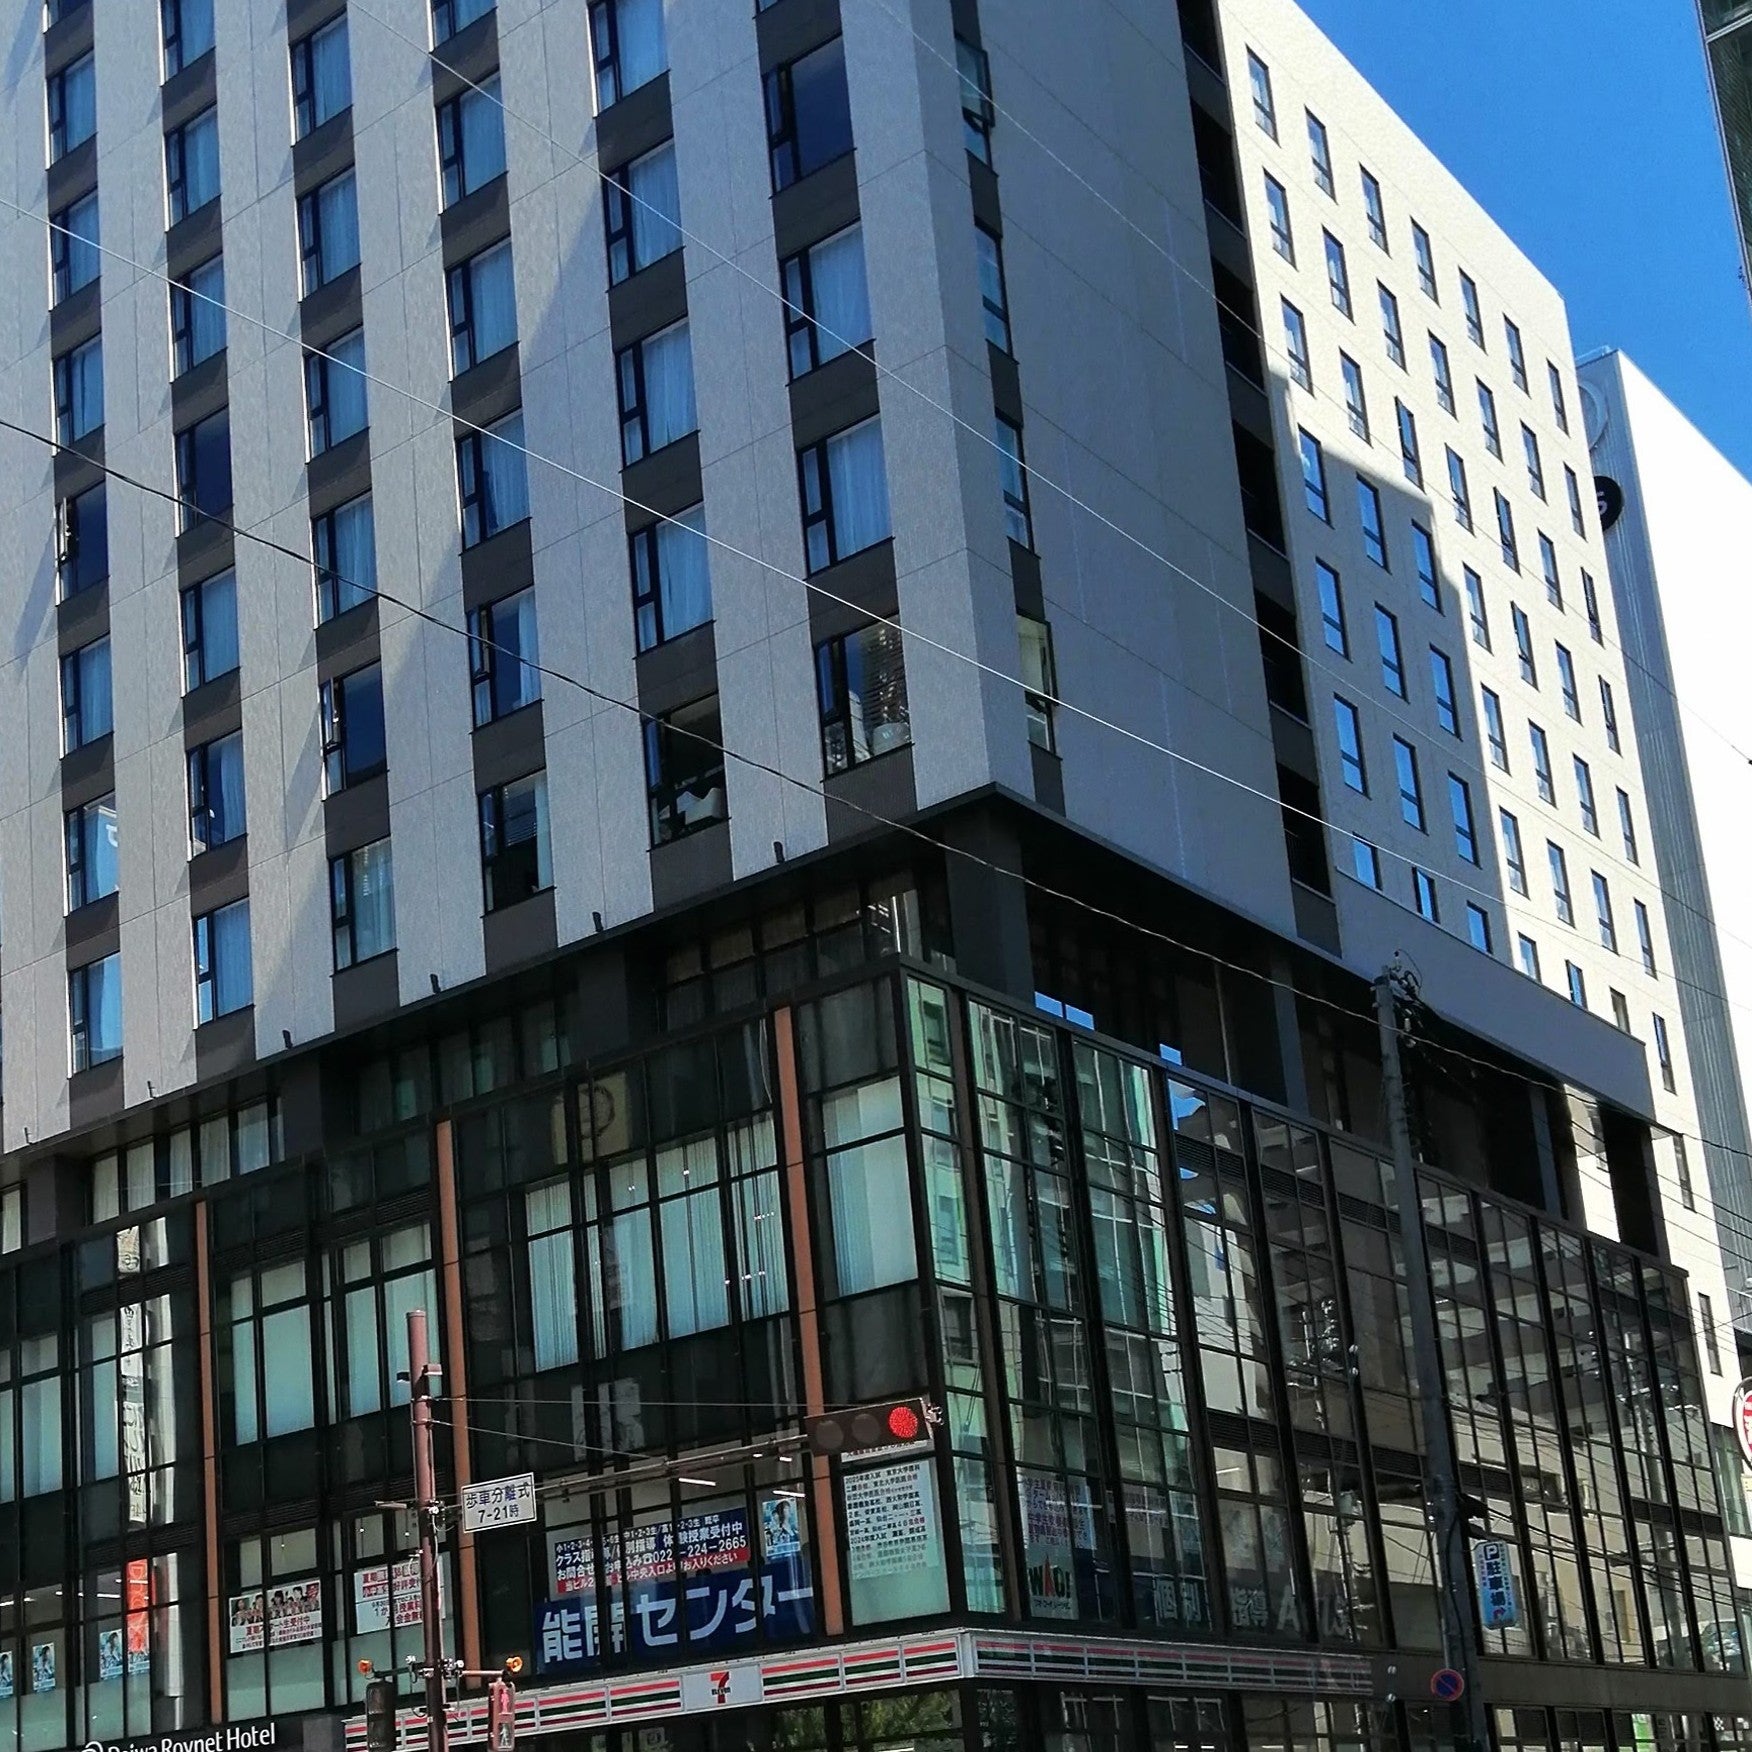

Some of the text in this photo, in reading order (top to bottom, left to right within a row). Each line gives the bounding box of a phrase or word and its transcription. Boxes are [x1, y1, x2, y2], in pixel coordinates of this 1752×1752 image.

[466, 1481, 530, 1510] 歩車分離式
[478, 1504, 519, 1523] 7-21時
[1486, 1546, 1498, 1560] P
[1487, 1561, 1506, 1607] 駐車場
[226, 1722, 275, 1751] Hotel
